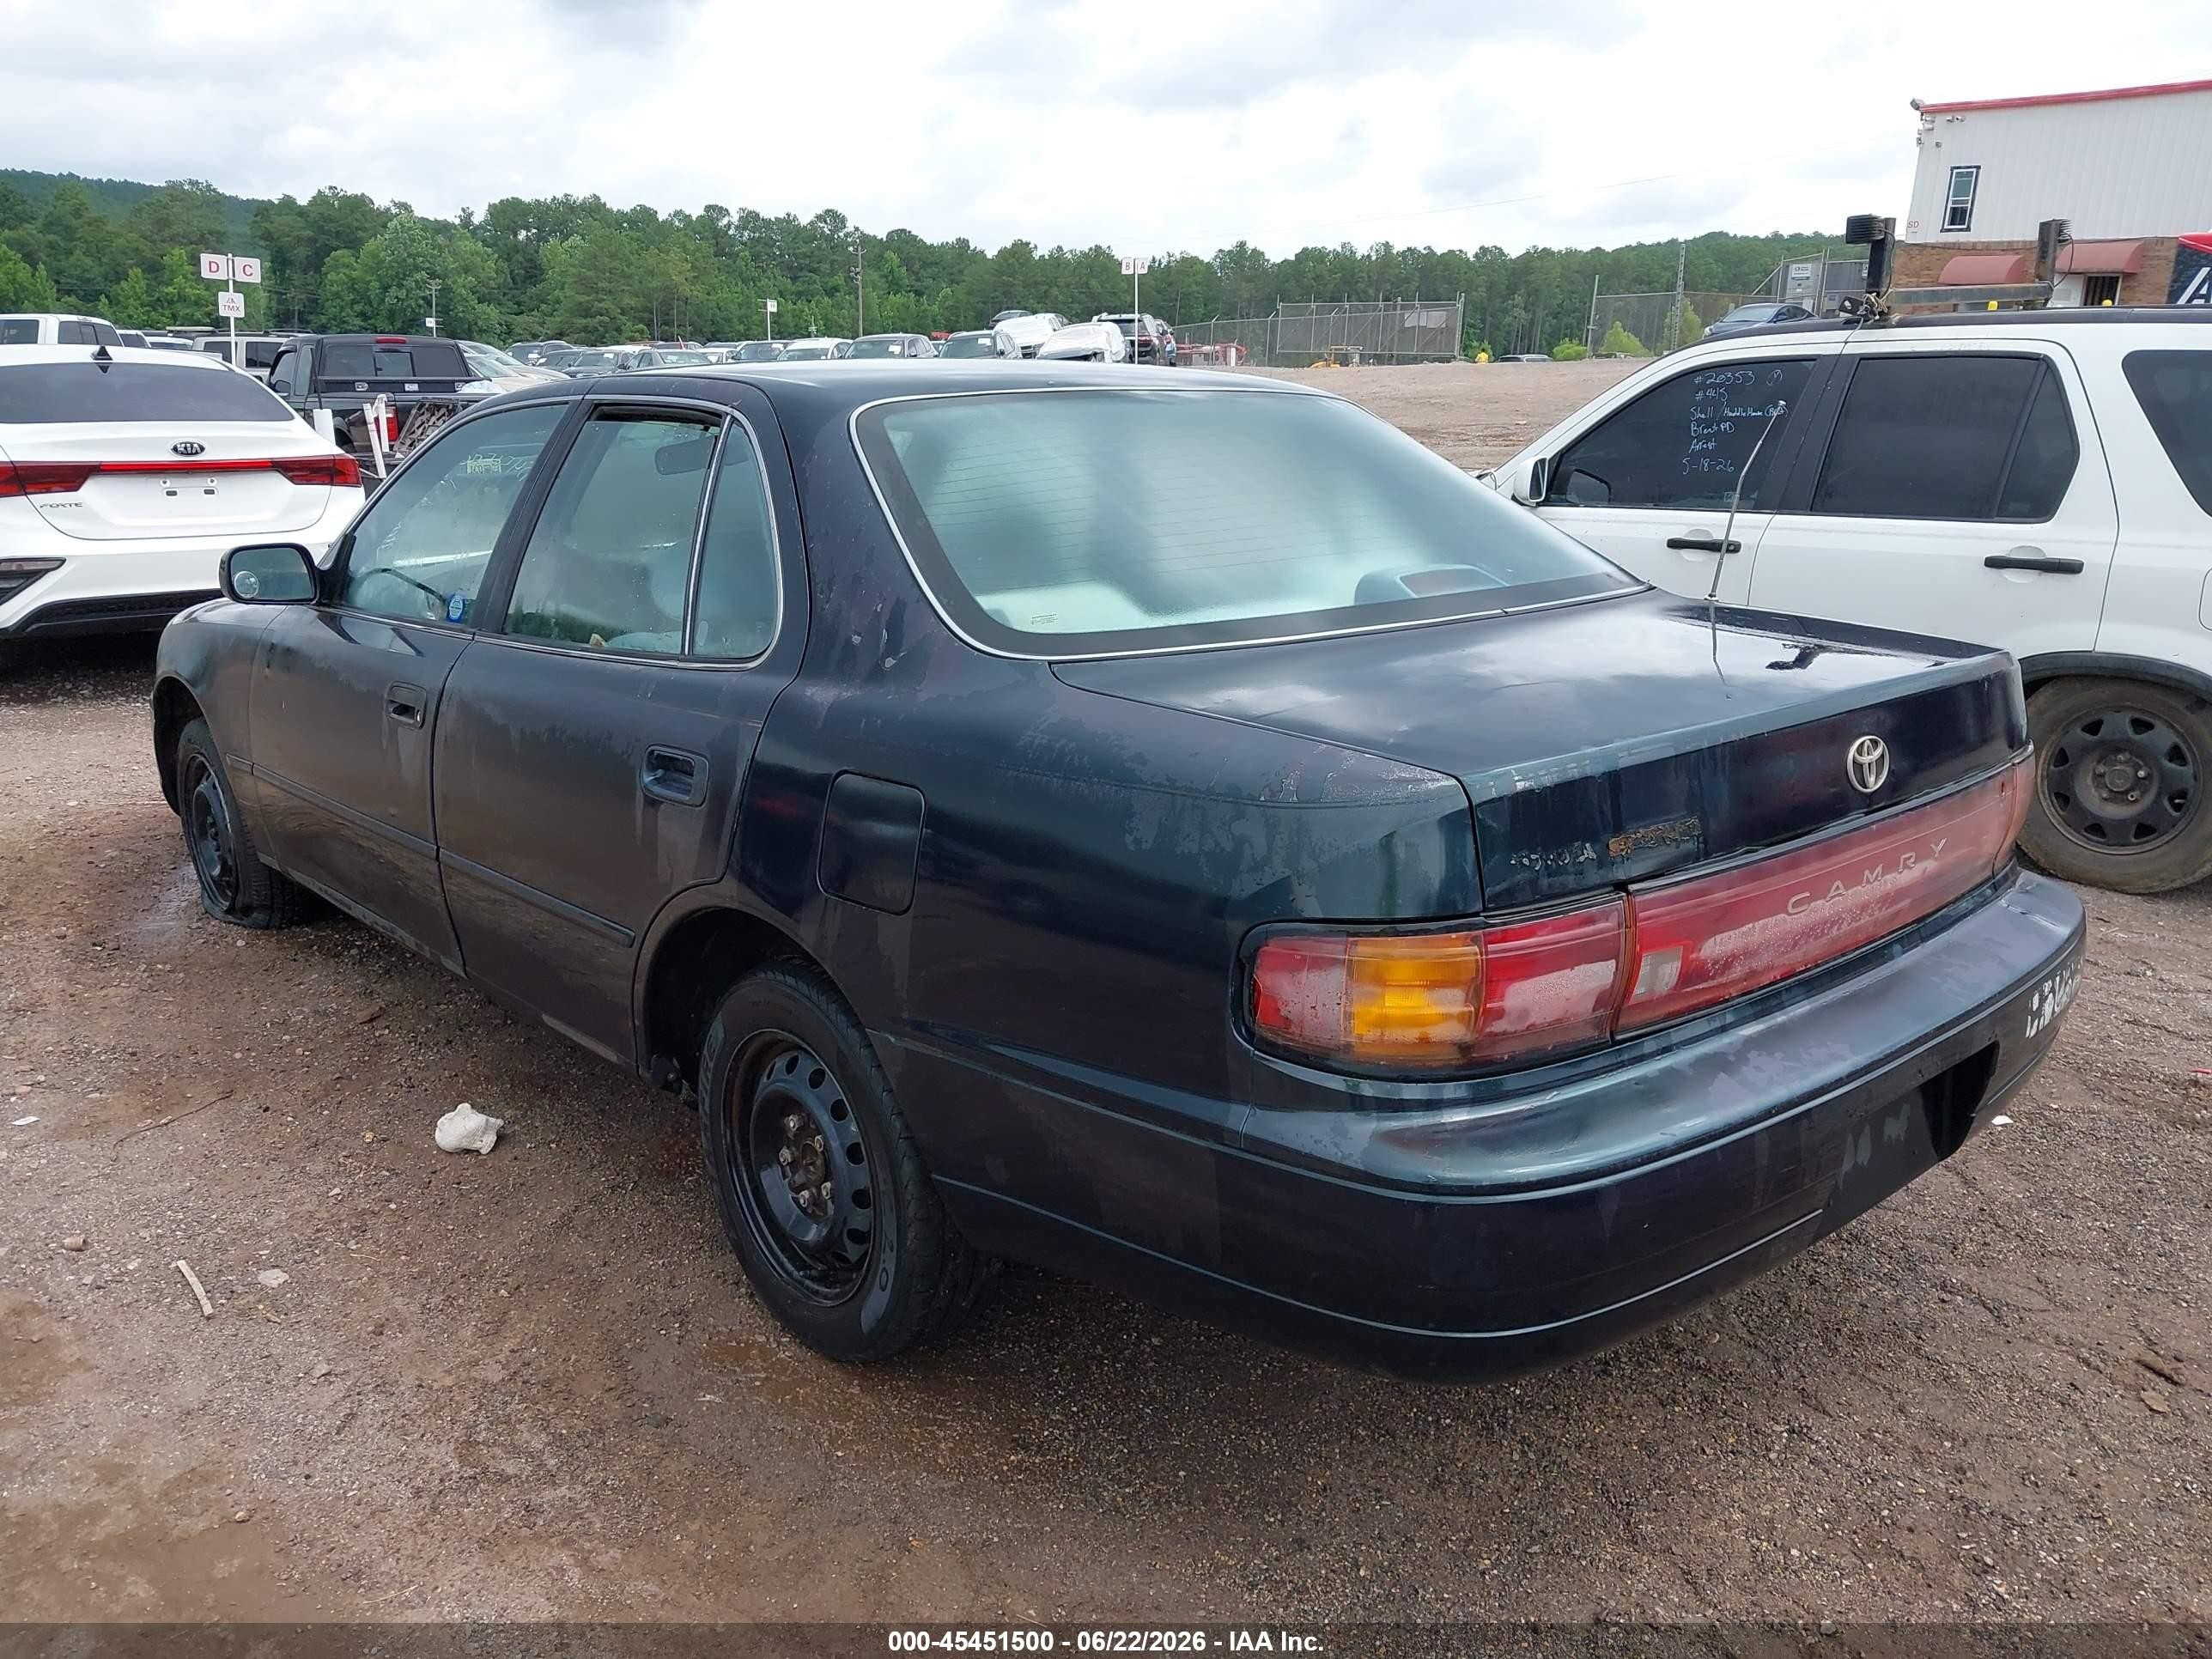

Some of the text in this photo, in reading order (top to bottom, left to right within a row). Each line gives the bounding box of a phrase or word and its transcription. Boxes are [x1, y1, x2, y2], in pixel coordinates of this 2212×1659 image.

[208, 260, 220, 273] D
[242, 264, 254, 276] C
[1125, 261, 1131, 270] B
[1139, 261, 1146, 270] A
[222, 304, 240, 313] TMX
[1693, 370, 1755, 386] #20353
[1690, 406, 1714, 421] Shell
[1720, 421, 1735, 434] PD
[176, 443, 201, 454] KIA
[1688, 438, 1717, 454] Arrest
[1682, 457, 1735, 475] 5-18-26
[1787, 837, 1948, 915] CAMRY
